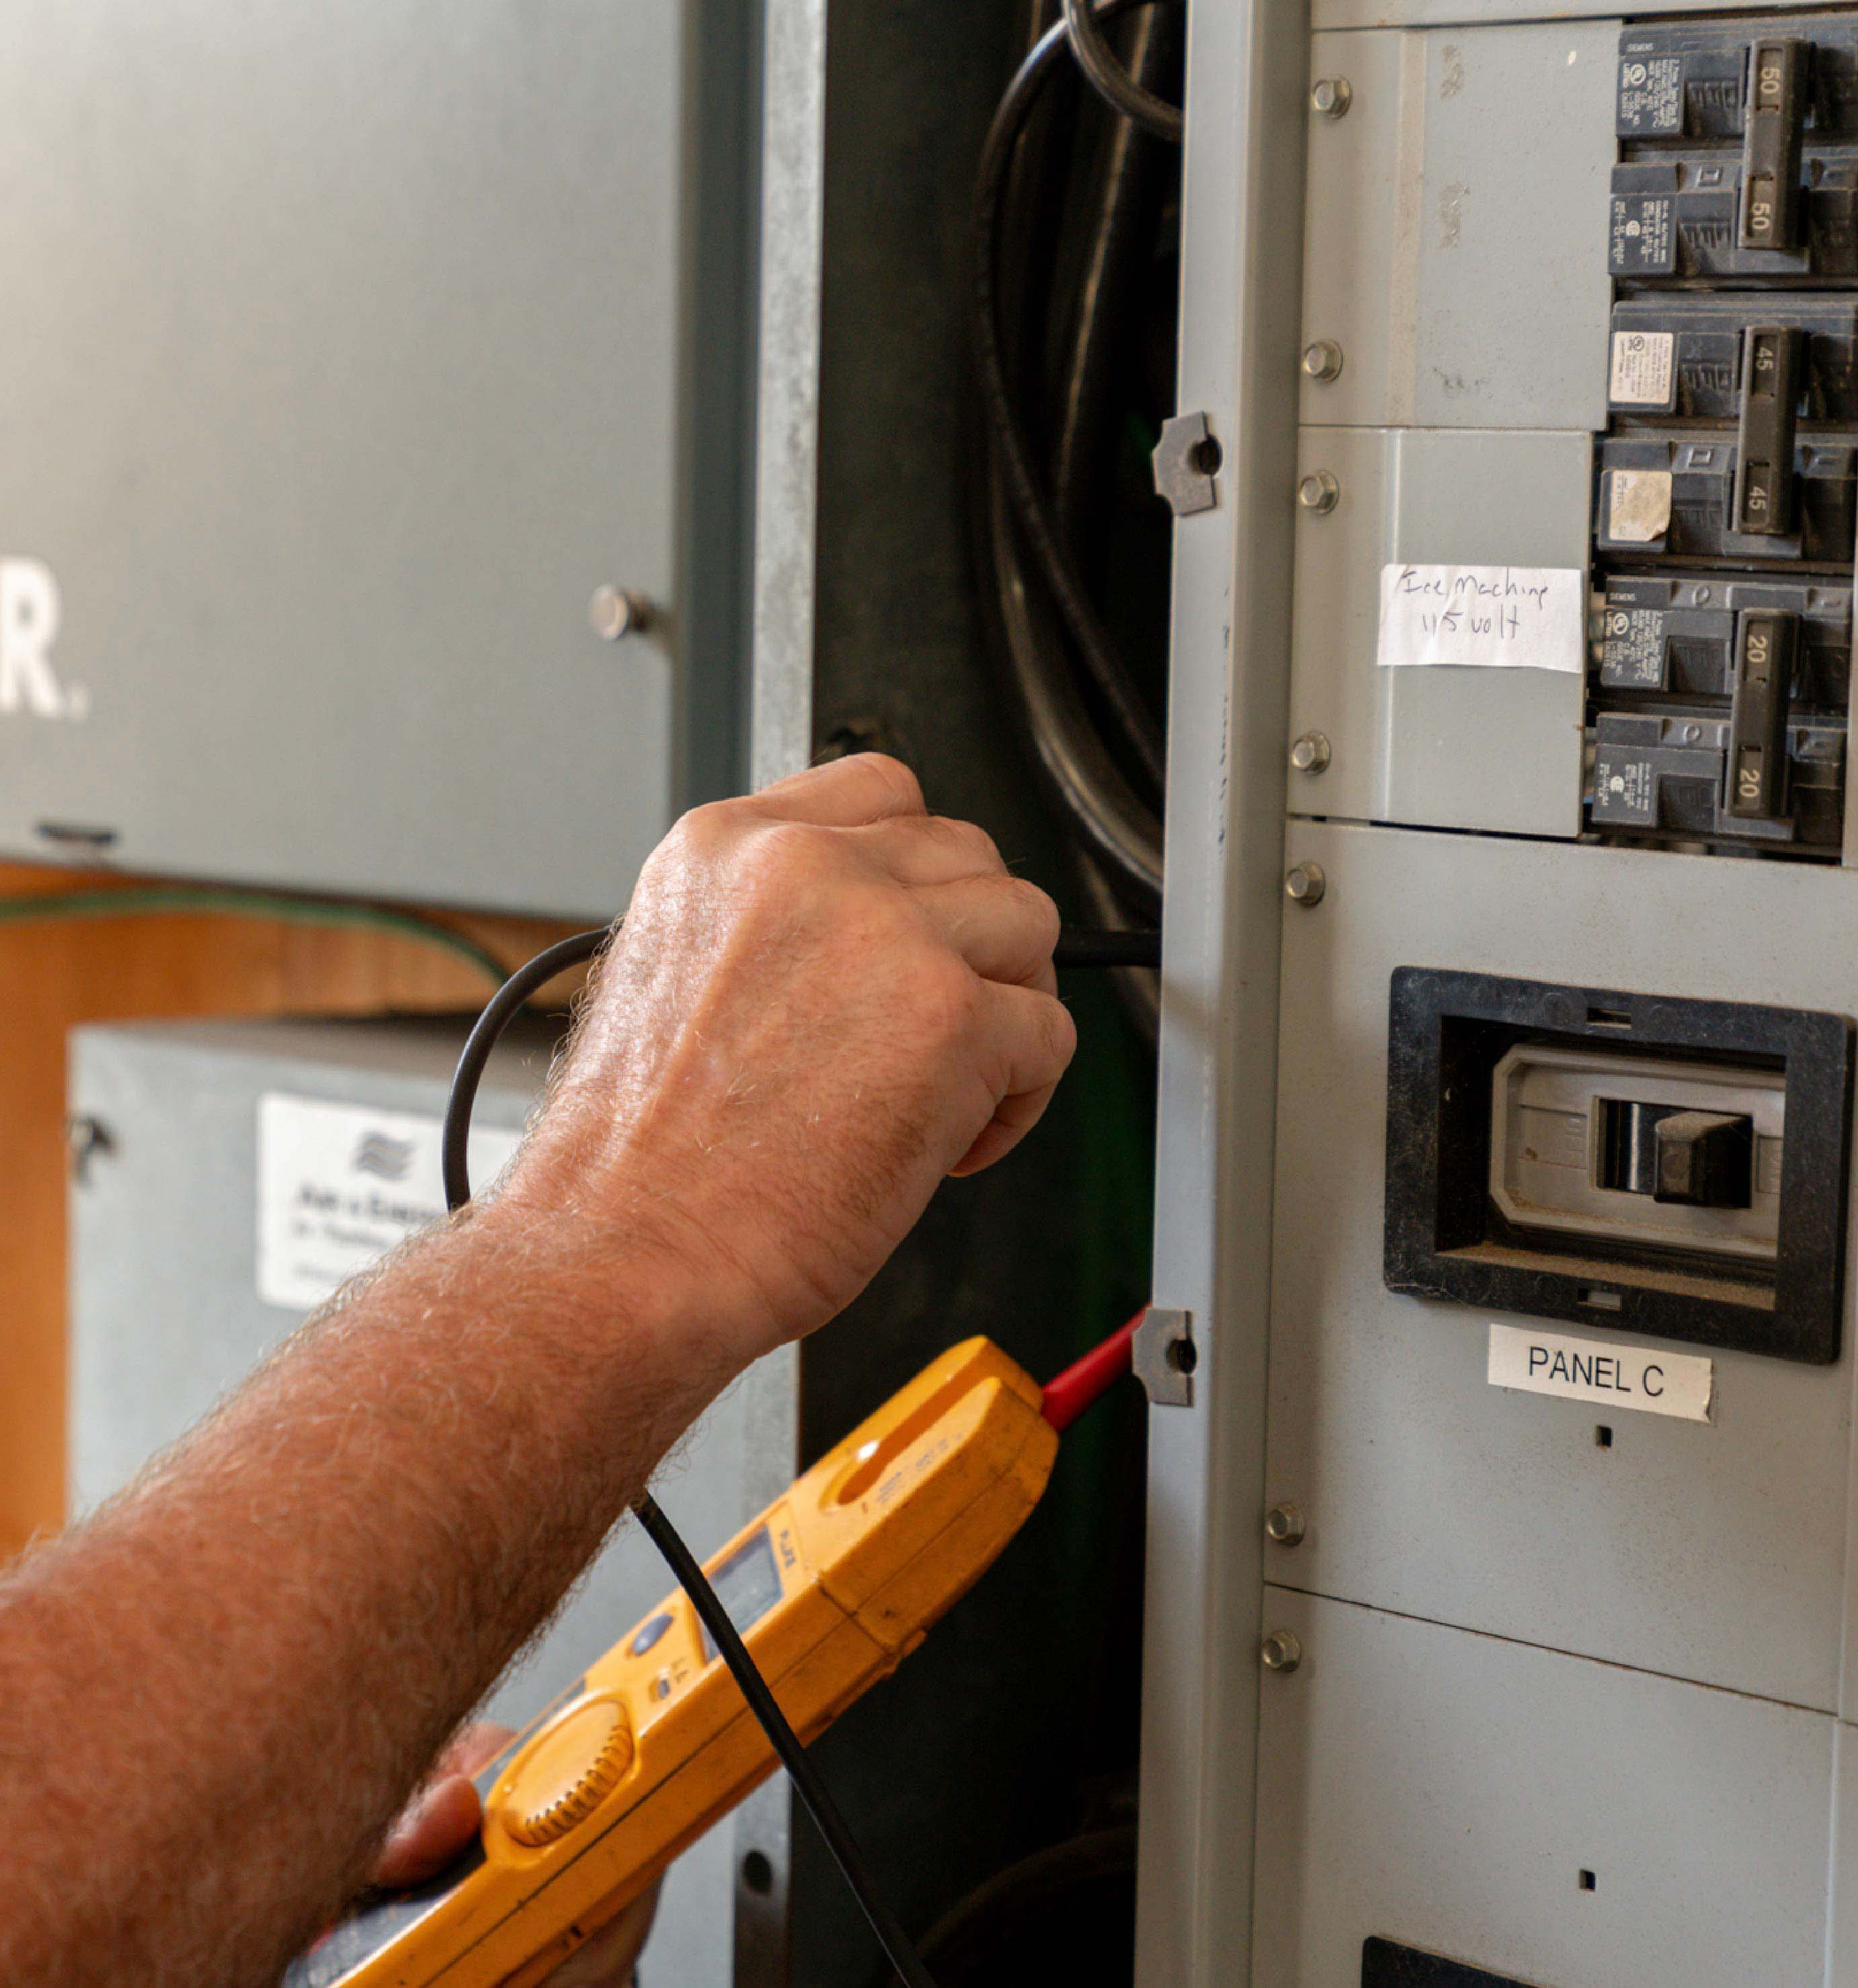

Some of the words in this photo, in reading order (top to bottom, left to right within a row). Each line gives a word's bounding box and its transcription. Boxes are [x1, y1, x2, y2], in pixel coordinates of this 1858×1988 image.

[1761, 67, 1780, 95] 50
[1752, 203, 1771, 230] 50
[1755, 346, 1775, 370] 45
[1748, 485, 1767, 511] 45
[1422, 612, 1463, 638] 115
[1748, 634, 1767, 663] 20
[1740, 769, 1760, 798] 20
[1529, 1345, 1631, 1393] PANEL
[1642, 1364, 1664, 1397] C
